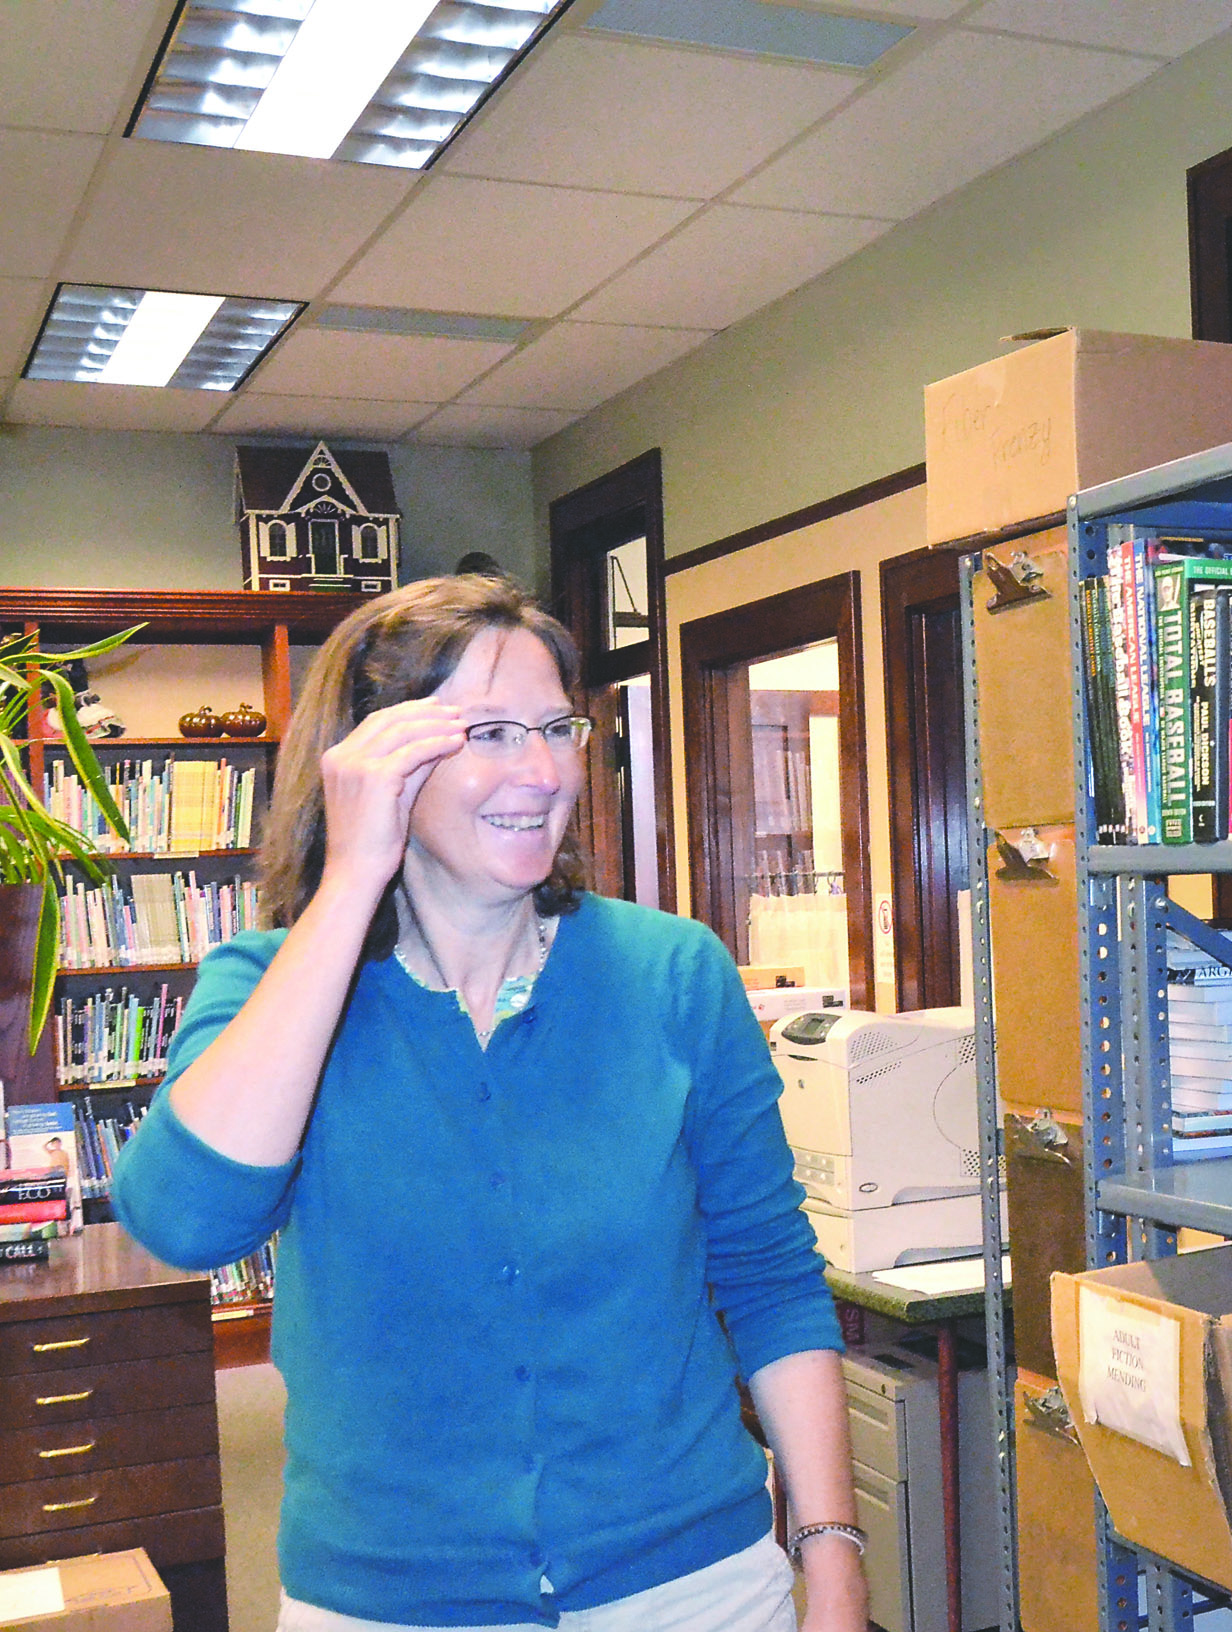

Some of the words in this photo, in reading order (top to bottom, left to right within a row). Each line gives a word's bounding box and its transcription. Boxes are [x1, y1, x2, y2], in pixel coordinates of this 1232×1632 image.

[1123, 556, 1133, 584] THE
[1134, 552, 1145, 584] THE
[1193, 566, 1204, 575] THE
[1206, 567, 1227, 576] OFFICIAL
[1112, 609, 1129, 697] Baseball
[1126, 587, 1137, 665] AMERICAN
[1137, 586, 1148, 665] NATIONAL
[1163, 610, 1183, 684] TOTAL
[1204, 599, 1217, 687] BASEBALL'S
[1130, 667, 1140, 723] LEAGUE
[1140, 666, 1150, 726] LEAGUE
[1201, 701, 1209, 731] PAUL
[1117, 699, 1132, 755] Book
[1165, 687, 1186, 806] BASEBALL
[1201, 733, 1209, 785] DICKSON
[1112, 1329, 1141, 1350] ADULT
[1112, 1347, 1145, 1369] FICTION
[1107, 1366, 1146, 1393] MENDING
